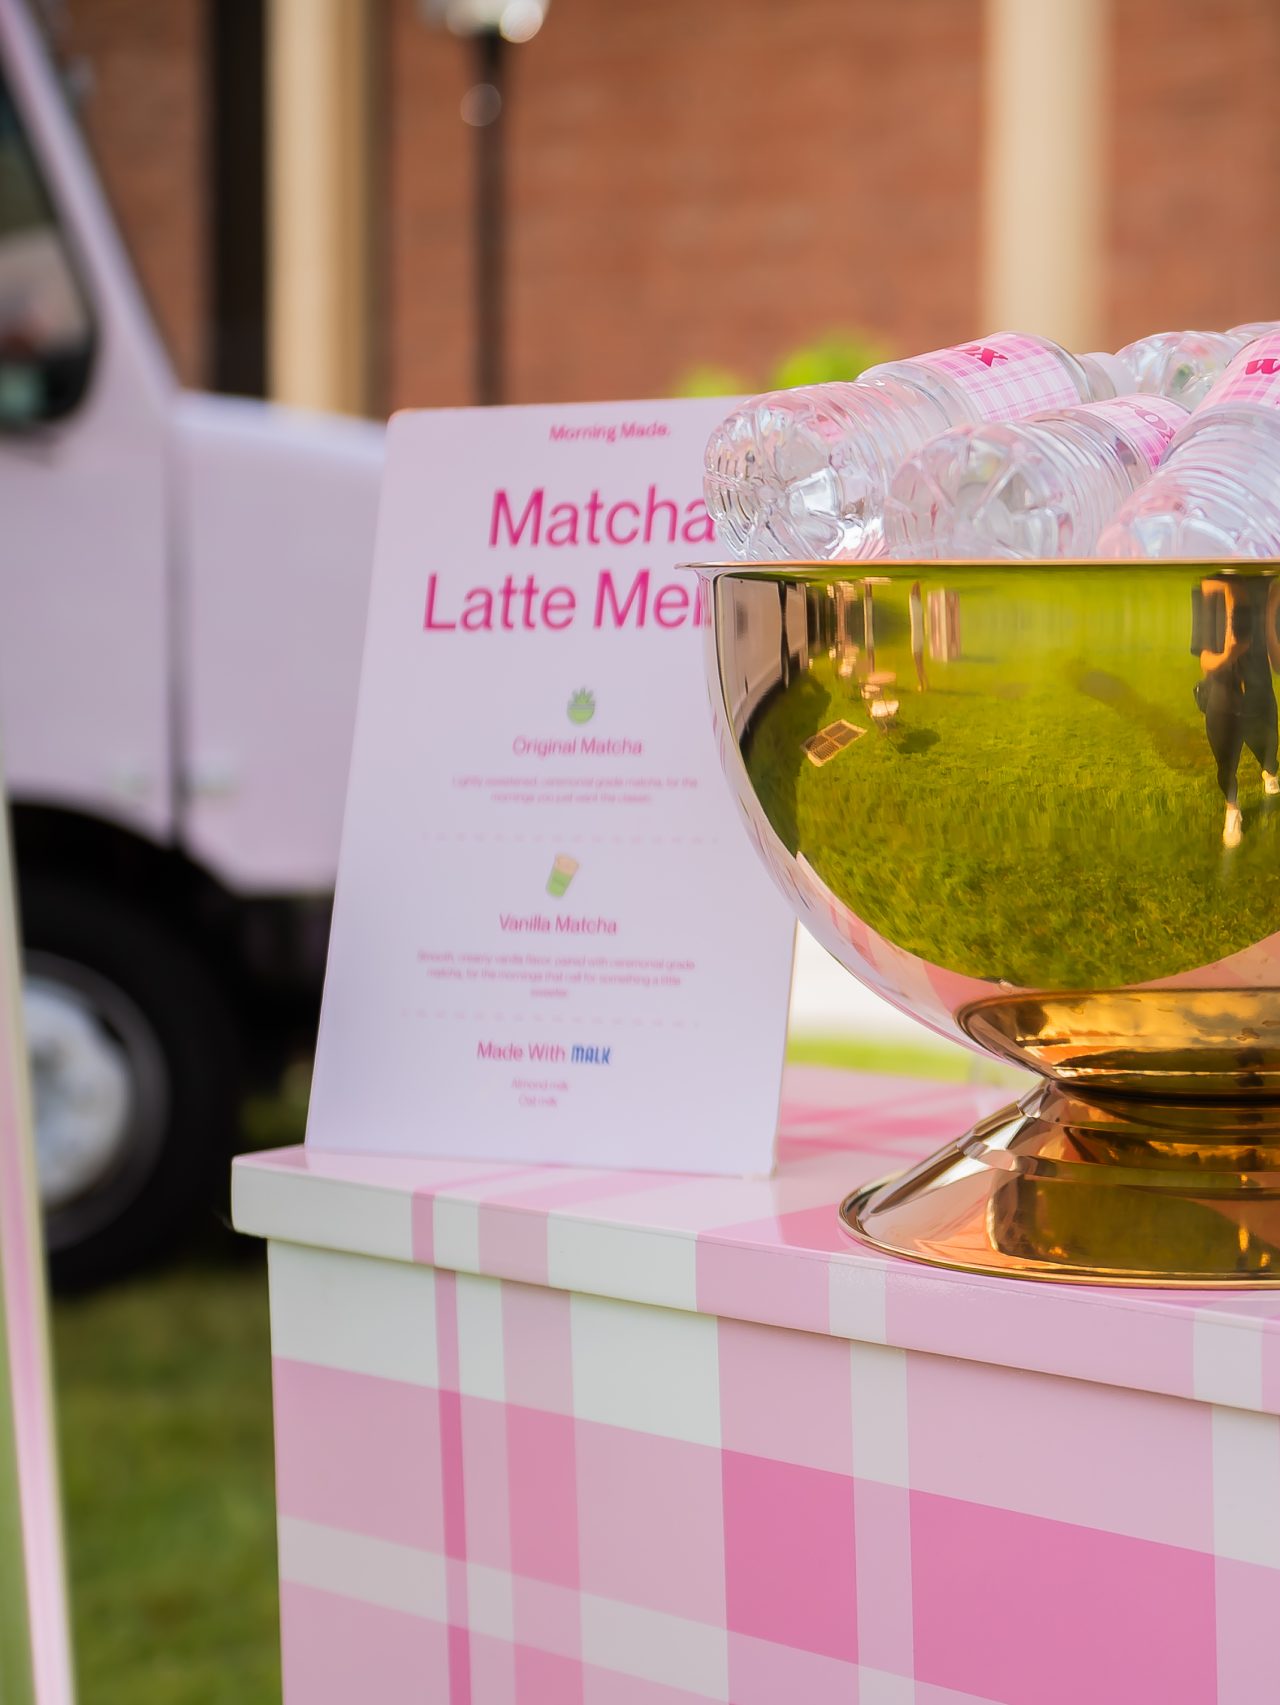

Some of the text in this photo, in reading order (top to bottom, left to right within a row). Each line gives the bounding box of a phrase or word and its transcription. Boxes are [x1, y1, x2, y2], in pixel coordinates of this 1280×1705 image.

[549, 421, 671, 443] Morning Made.
[488, 483, 715, 548] Matcha
[423, 568, 702, 632] Latte Me
[513, 735, 643, 757] Original Matcha
[499, 914, 617, 936] Vanilla Matcha
[477, 1040, 611, 1065] Made With MALK
